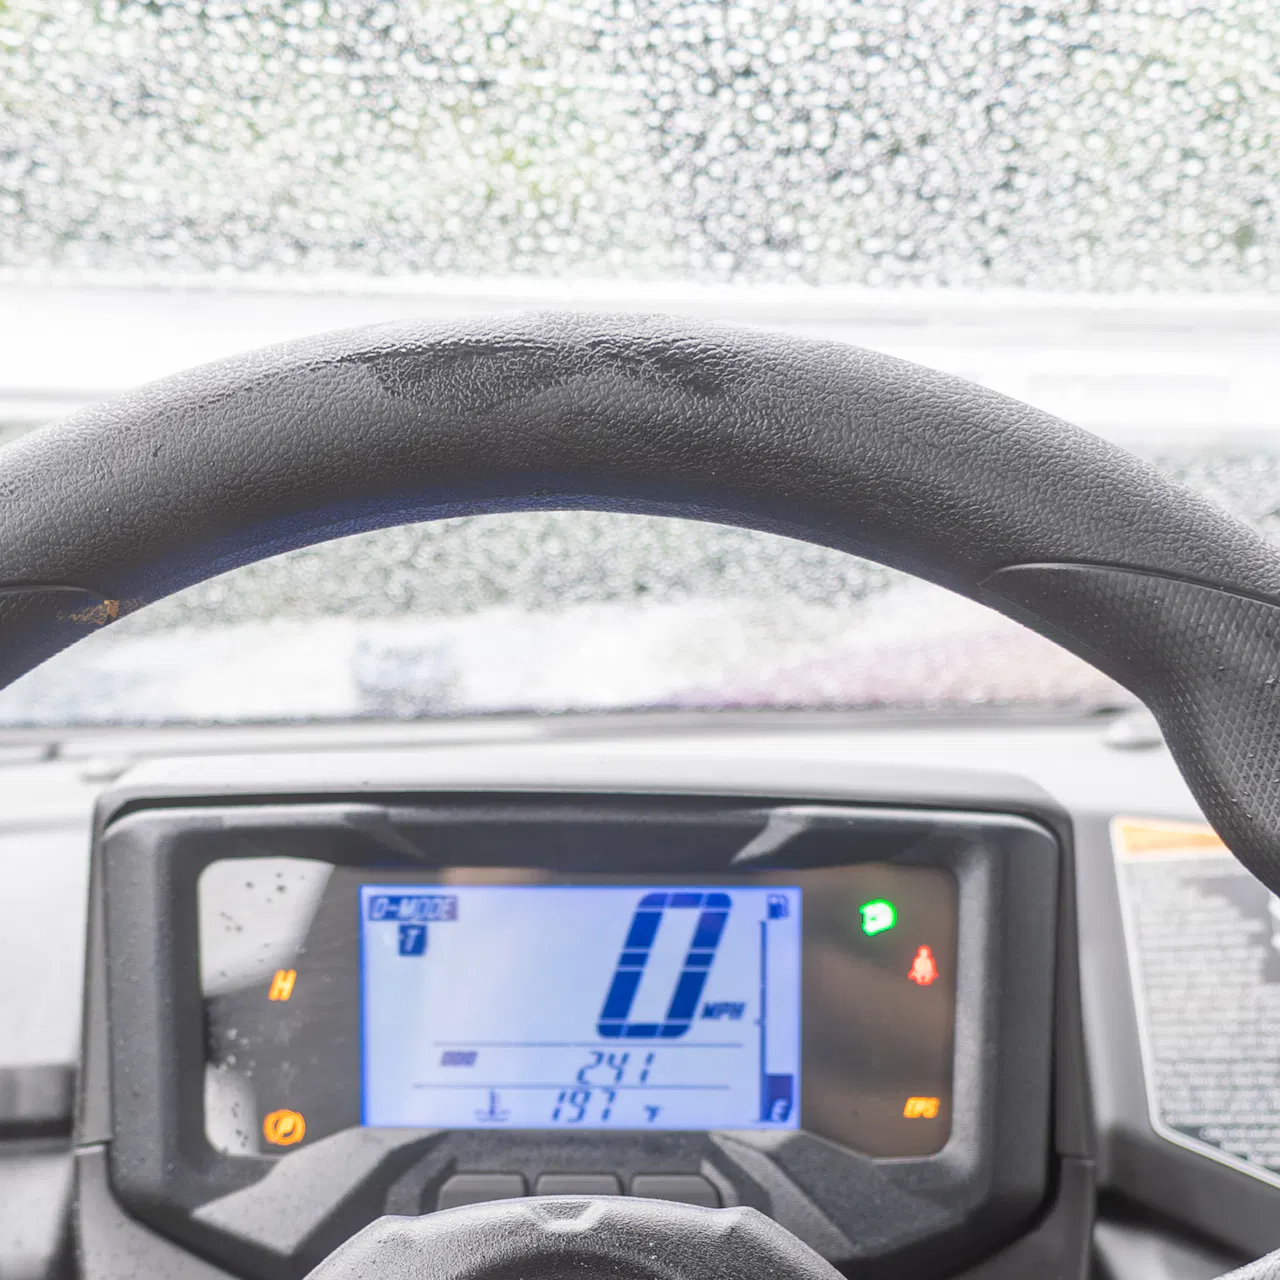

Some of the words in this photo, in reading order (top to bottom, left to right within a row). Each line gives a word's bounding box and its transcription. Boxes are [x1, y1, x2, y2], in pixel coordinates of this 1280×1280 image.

[596, 892, 732, 1039] 0
[268, 969, 297, 1001] H
[576, 1050, 655, 1087] 241
[551, 1088, 617, 1123] 197
